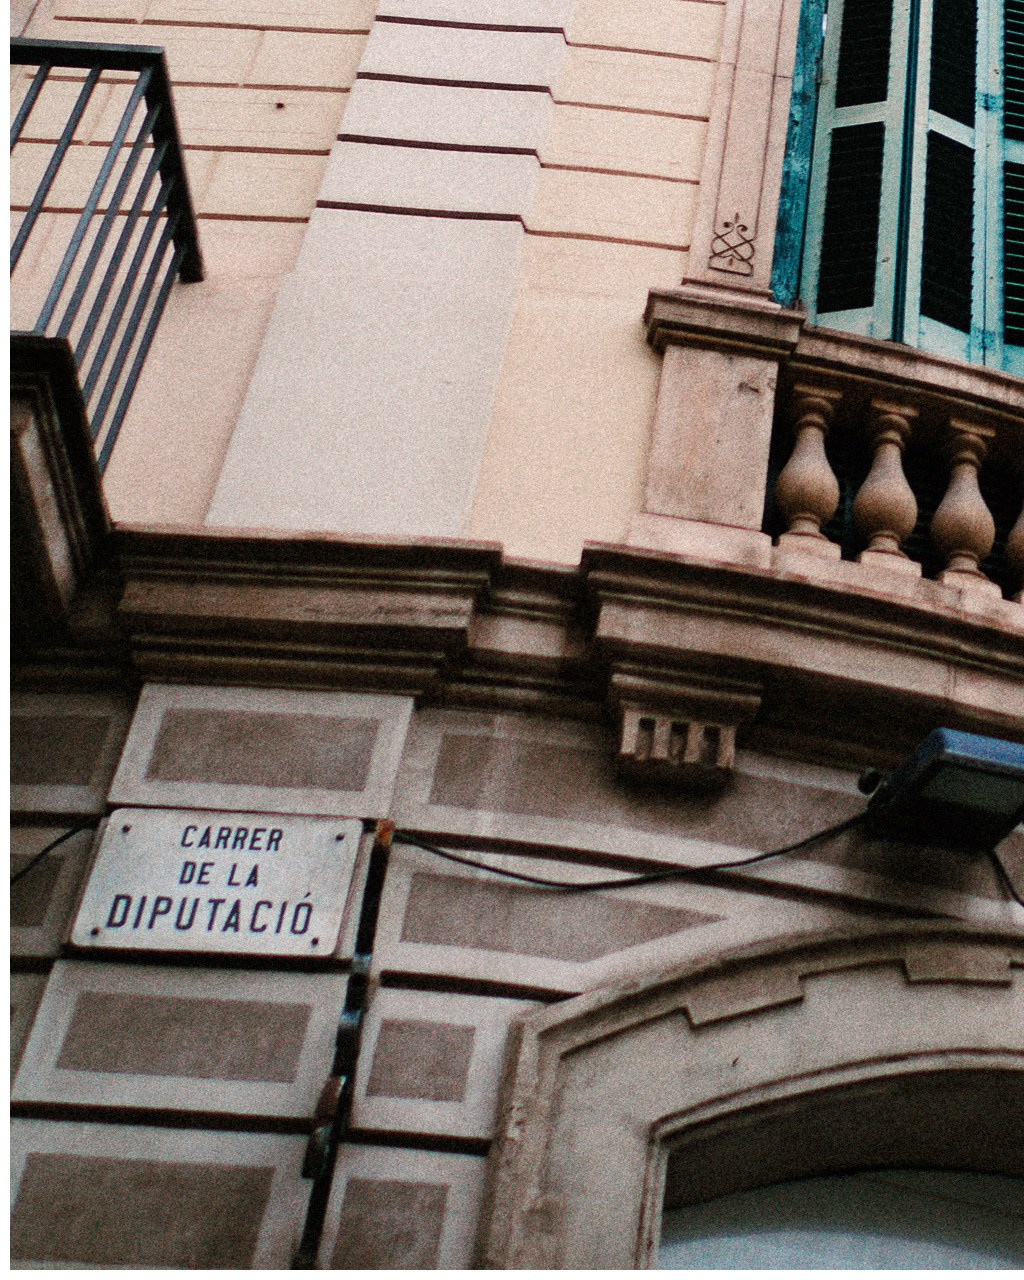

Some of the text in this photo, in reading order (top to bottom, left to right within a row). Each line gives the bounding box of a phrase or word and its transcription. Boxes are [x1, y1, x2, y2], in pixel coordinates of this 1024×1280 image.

[181, 825, 283, 851] CARRER
[179, 861, 259, 887] DE LA
[106, 892, 313, 935] DIPUTACIÓ
